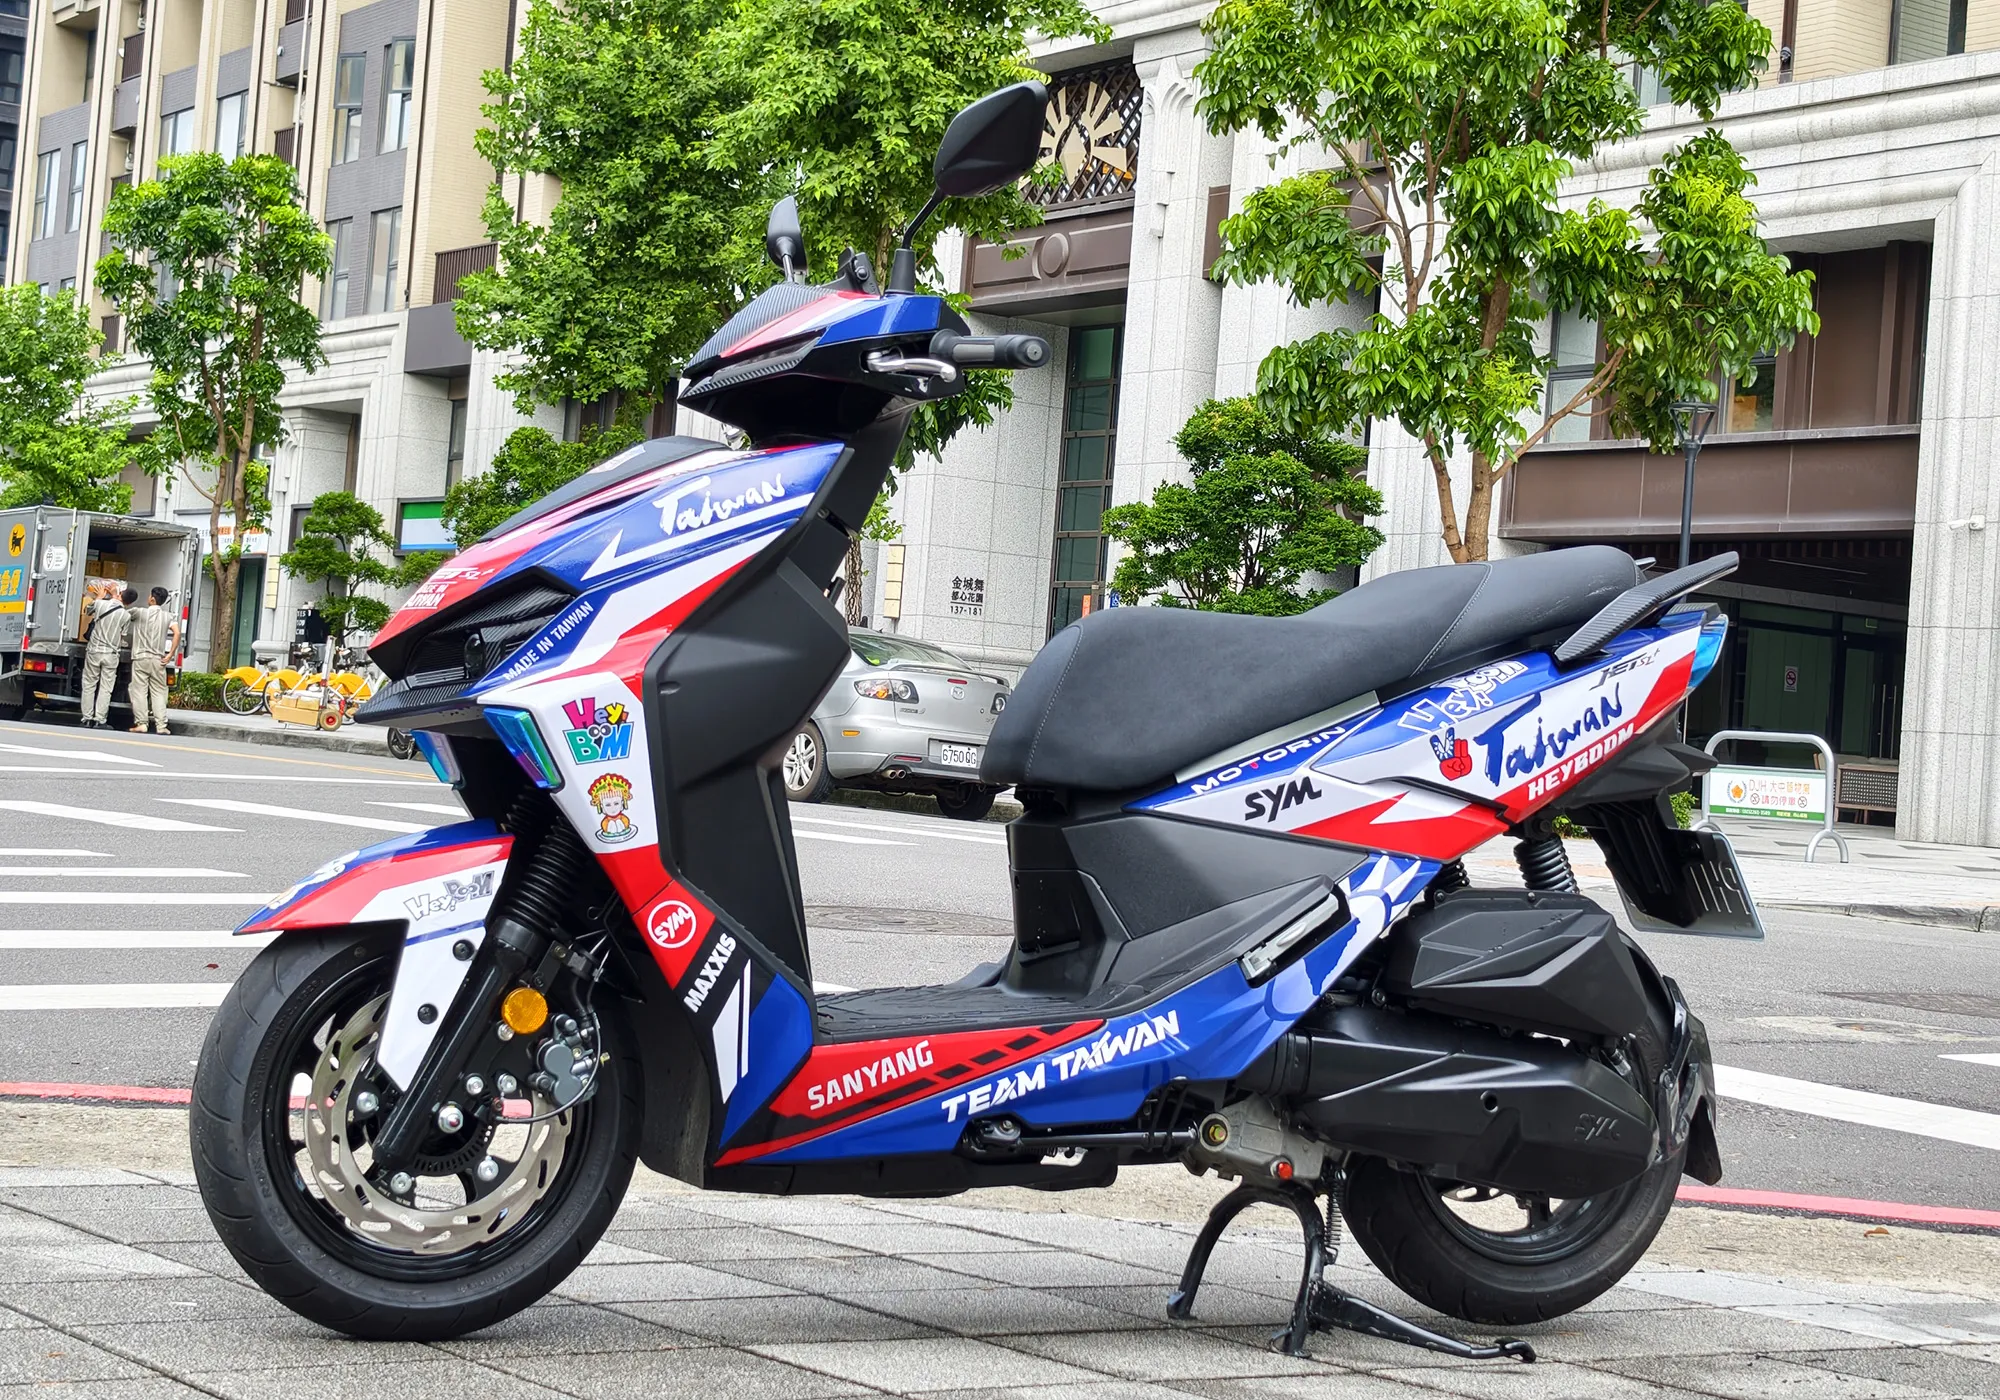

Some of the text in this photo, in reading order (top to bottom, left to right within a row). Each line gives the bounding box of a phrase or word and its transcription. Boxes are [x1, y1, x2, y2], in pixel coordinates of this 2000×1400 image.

[950, 605, 983, 616] 137-181
[951, 590, 984, 603] 都心花園
[952, 575, 985, 592] 金城舞
[503, 601, 594, 681] MADE IN TAIWAN
[1528, 723, 1634, 800] HEYBOOM
[1245, 776, 1323, 823] SYM
[654, 906, 693, 944] SYM
[683, 932, 737, 1013] MAXXIS
[807, 1040, 934, 1110] SANYANG
[941, 1009, 1181, 1123] TEAM TAIWAN
